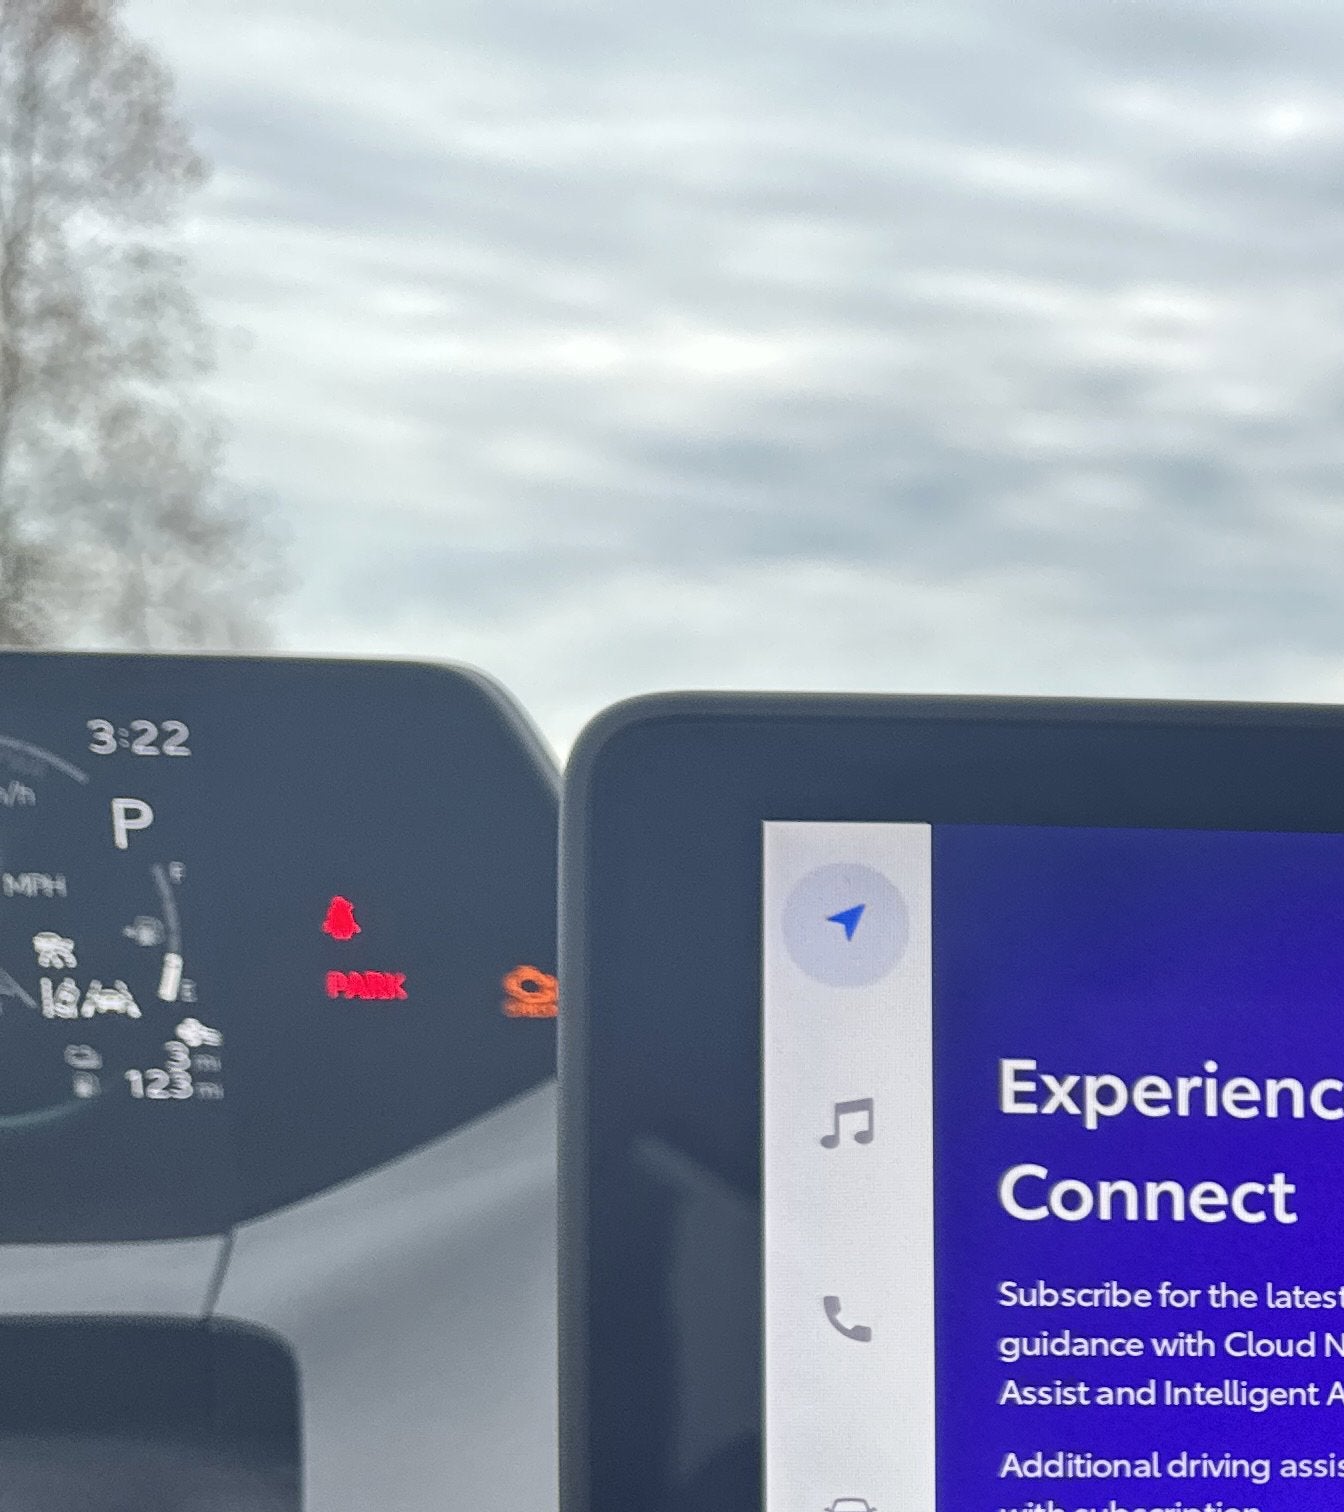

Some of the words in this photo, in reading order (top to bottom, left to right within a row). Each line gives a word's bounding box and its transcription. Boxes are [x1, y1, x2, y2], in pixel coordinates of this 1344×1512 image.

[86, 718, 192, 756] 3:22
[111, 797, 154, 850] P
[124, 1068, 193, 1099] 123
[999, 1163, 1298, 1225] Connect
[998, 1279, 1153, 1308] Subscribe
[1157, 1280, 1202, 1309] for
[1207, 1281, 1258, 1309] the
[998, 1329, 1145, 1363] guidance
[1150, 1330, 1216, 1357] with
[1224, 1330, 1316, 1359] Cloud
[999, 1379, 1091, 1406] Assist
[1095, 1378, 1156, 1406] and
[1164, 1379, 1321, 1413] Intelligent
[999, 1451, 1162, 1479] Additional
[1166, 1451, 1272, 1485] driving
